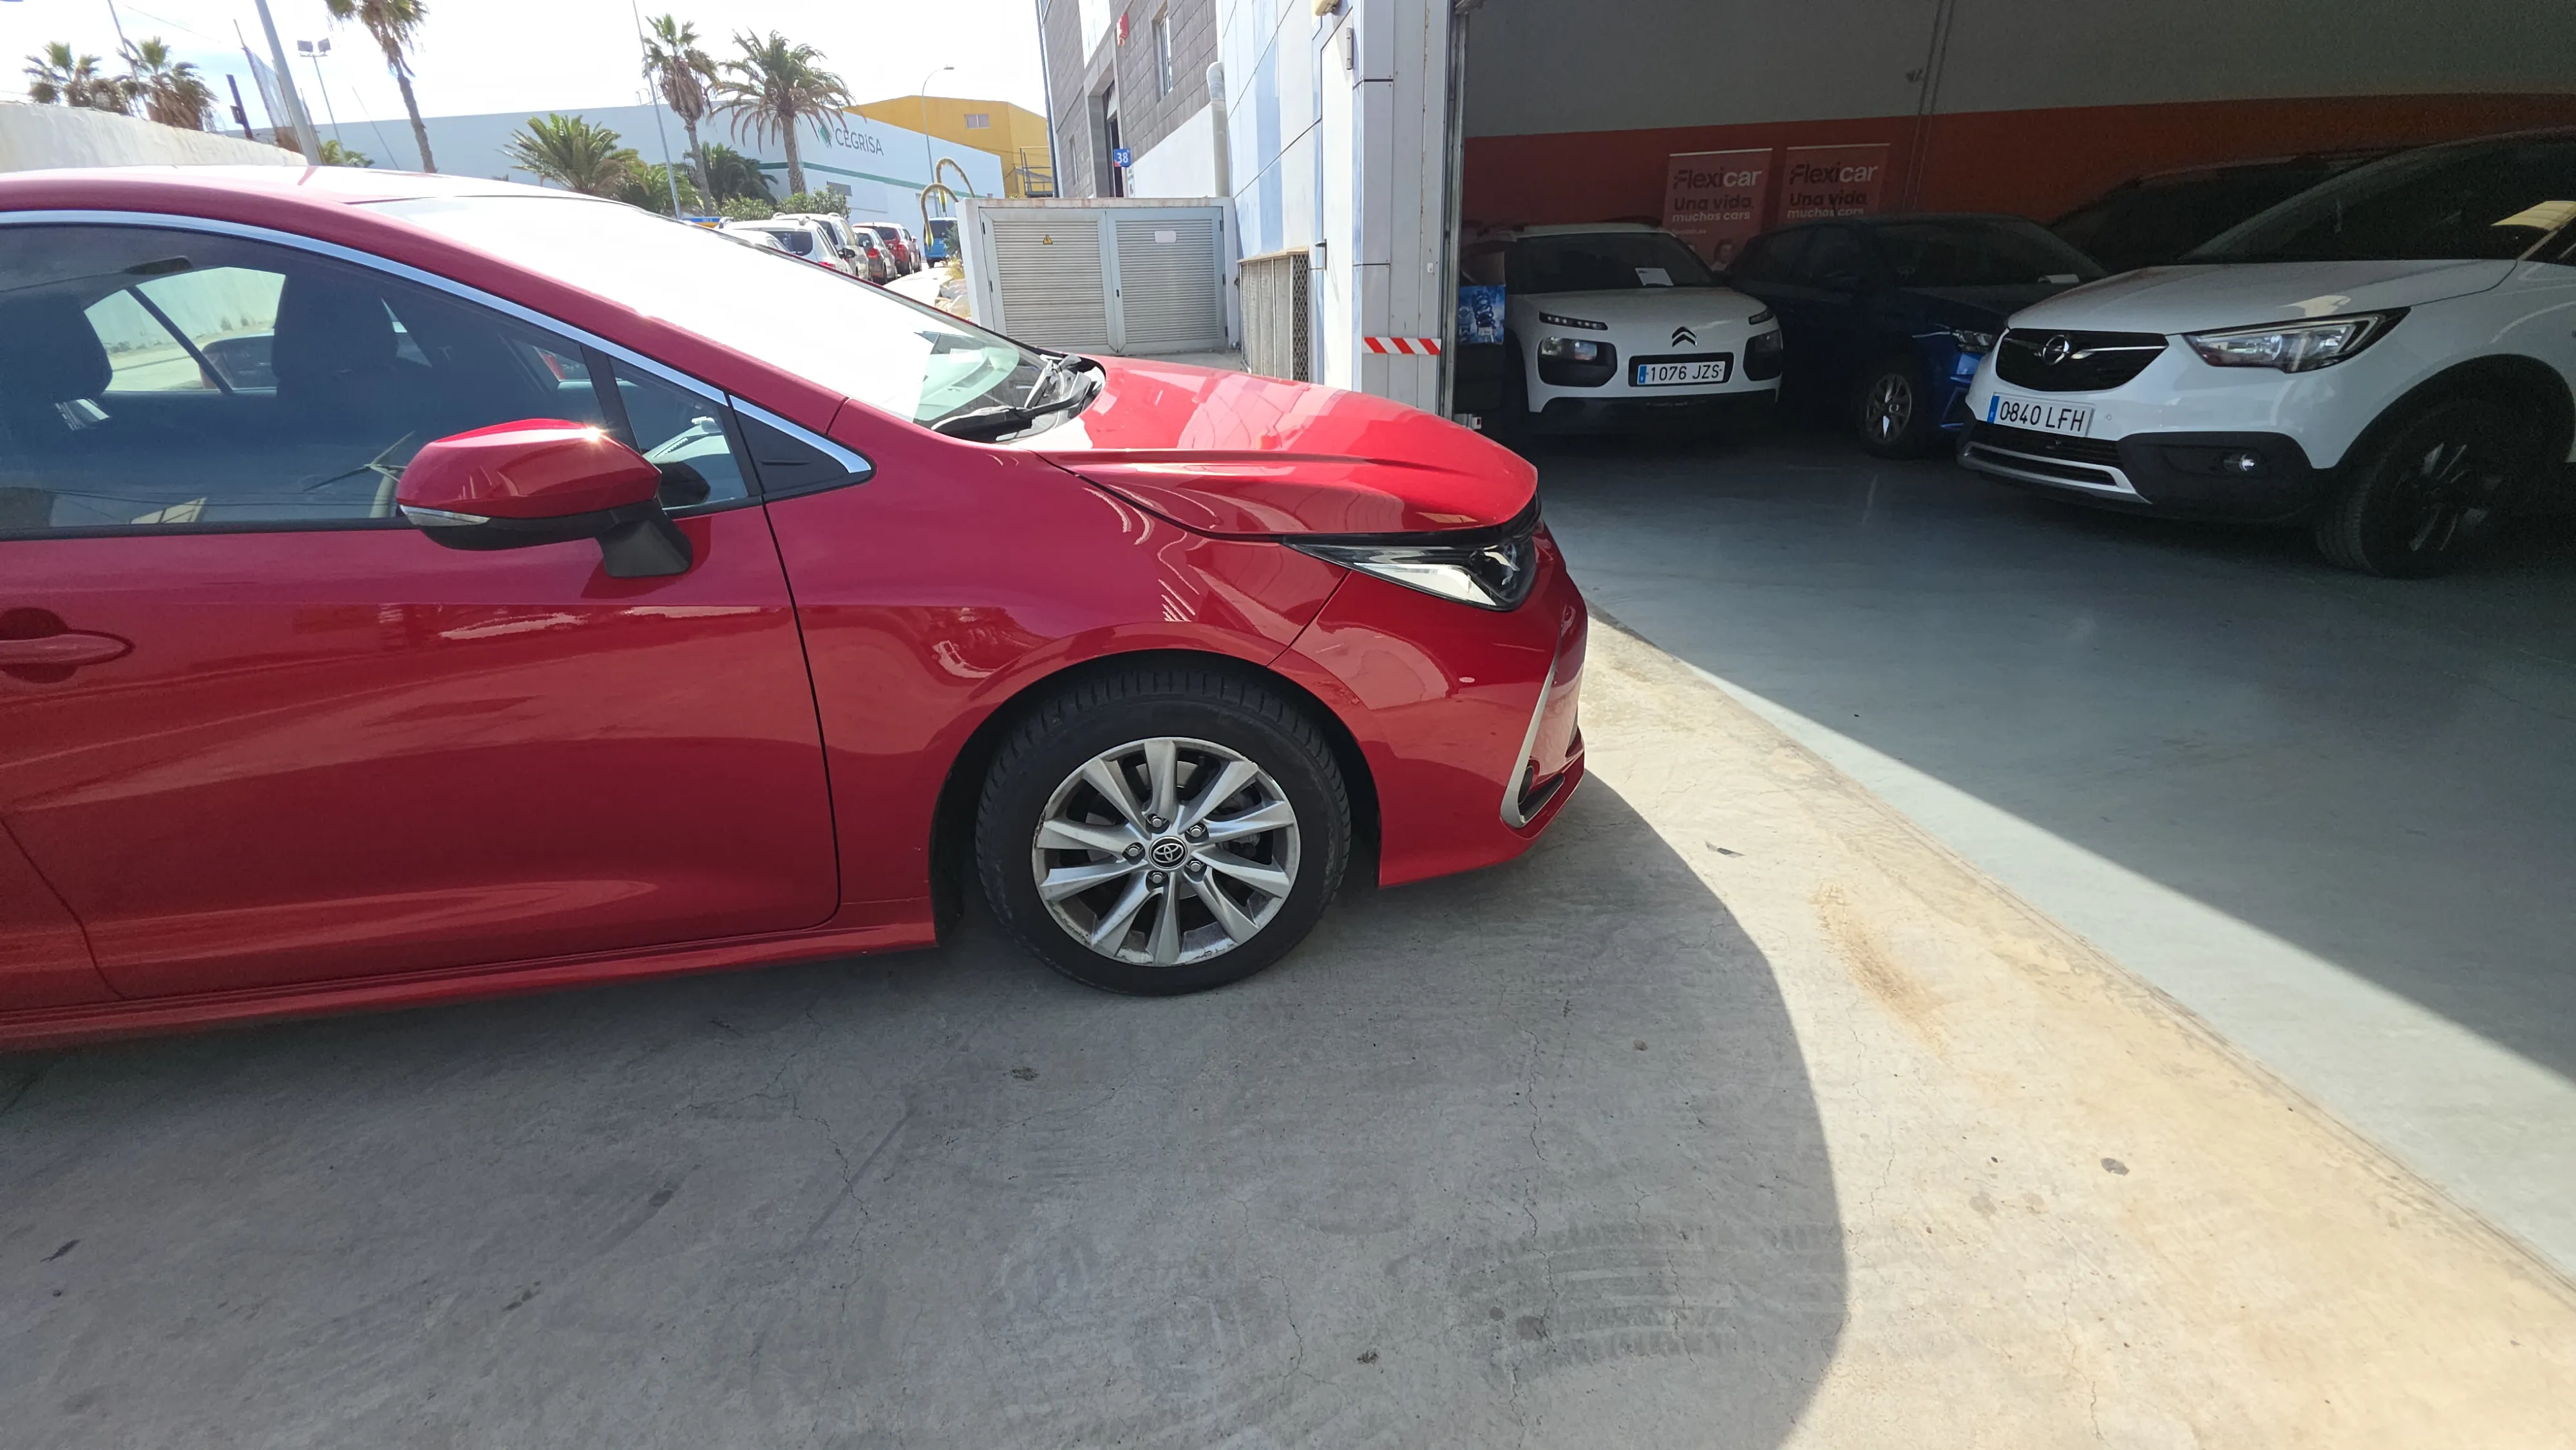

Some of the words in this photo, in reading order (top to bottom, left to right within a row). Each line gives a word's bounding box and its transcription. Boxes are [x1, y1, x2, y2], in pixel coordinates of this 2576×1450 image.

[1117, 152, 1129, 164] 38
[1672, 166, 1762, 189] Flexicar
[1789, 162, 1879, 185] Flexicar
[1674, 197, 1709, 211] Una
[1790, 193, 1824, 207] Una
[1672, 211, 1721, 222] muchos
[1723, 211, 1750, 220] cars
[1787, 207, 1835, 219] muchos
[1651, 366, 1687, 382] 1076
[1692, 364, 1719, 380] JZS
[2000, 400, 2041, 426] 0840
[2045, 406, 2086, 431] LFH
